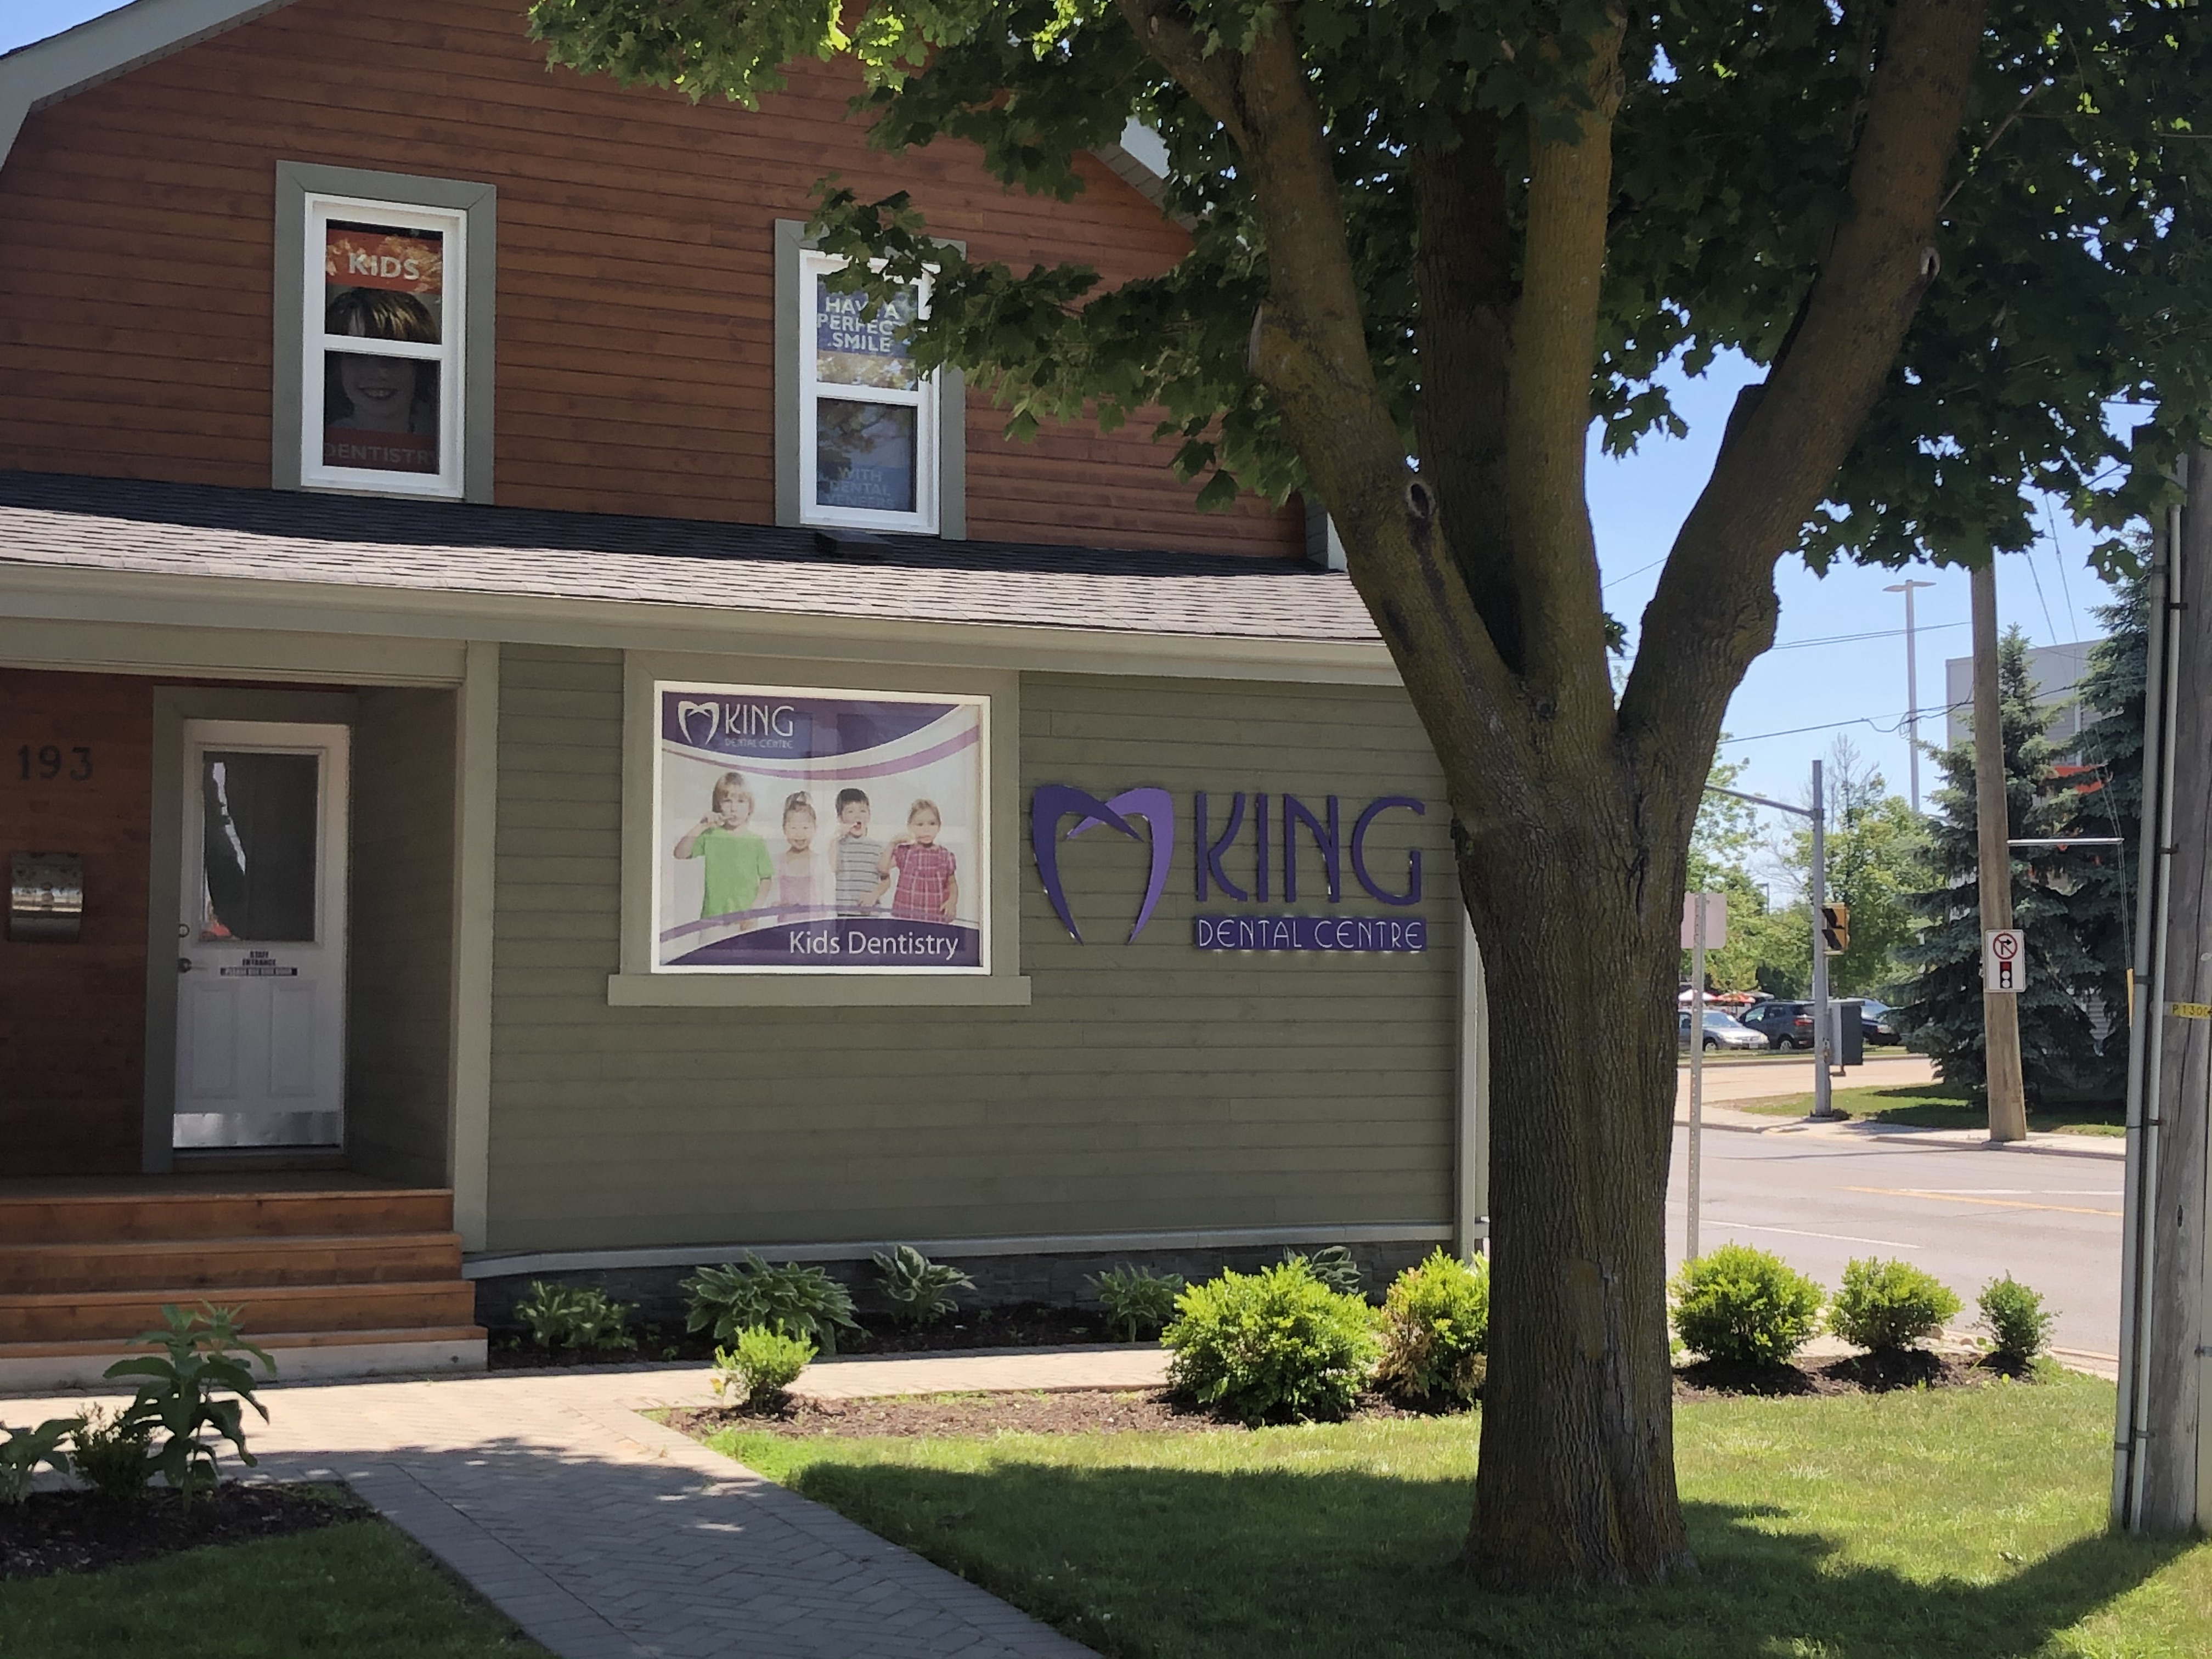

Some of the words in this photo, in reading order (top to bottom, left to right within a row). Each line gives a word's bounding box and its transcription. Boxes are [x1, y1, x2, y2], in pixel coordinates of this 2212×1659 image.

[348, 253, 420, 280] KIDS
[826, 297, 880, 317] HAV
[884, 303, 900, 320] A
[832, 332, 891, 352] SMILE
[838, 466, 882, 482] WITH
[826, 493, 895, 509] VENEERS
[725, 703, 794, 736] KING
[725, 738, 757, 748] DENTAL
[759, 739, 793, 749] CENTRE
[18, 744, 93, 781] 193
[1197, 792, 1425, 905] KING
[790, 931, 840, 954] Kids
[848, 933, 958, 960] Dentistry
[1198, 919, 1302, 948] DENTAL
[1314, 921, 1423, 950] CENTRE
